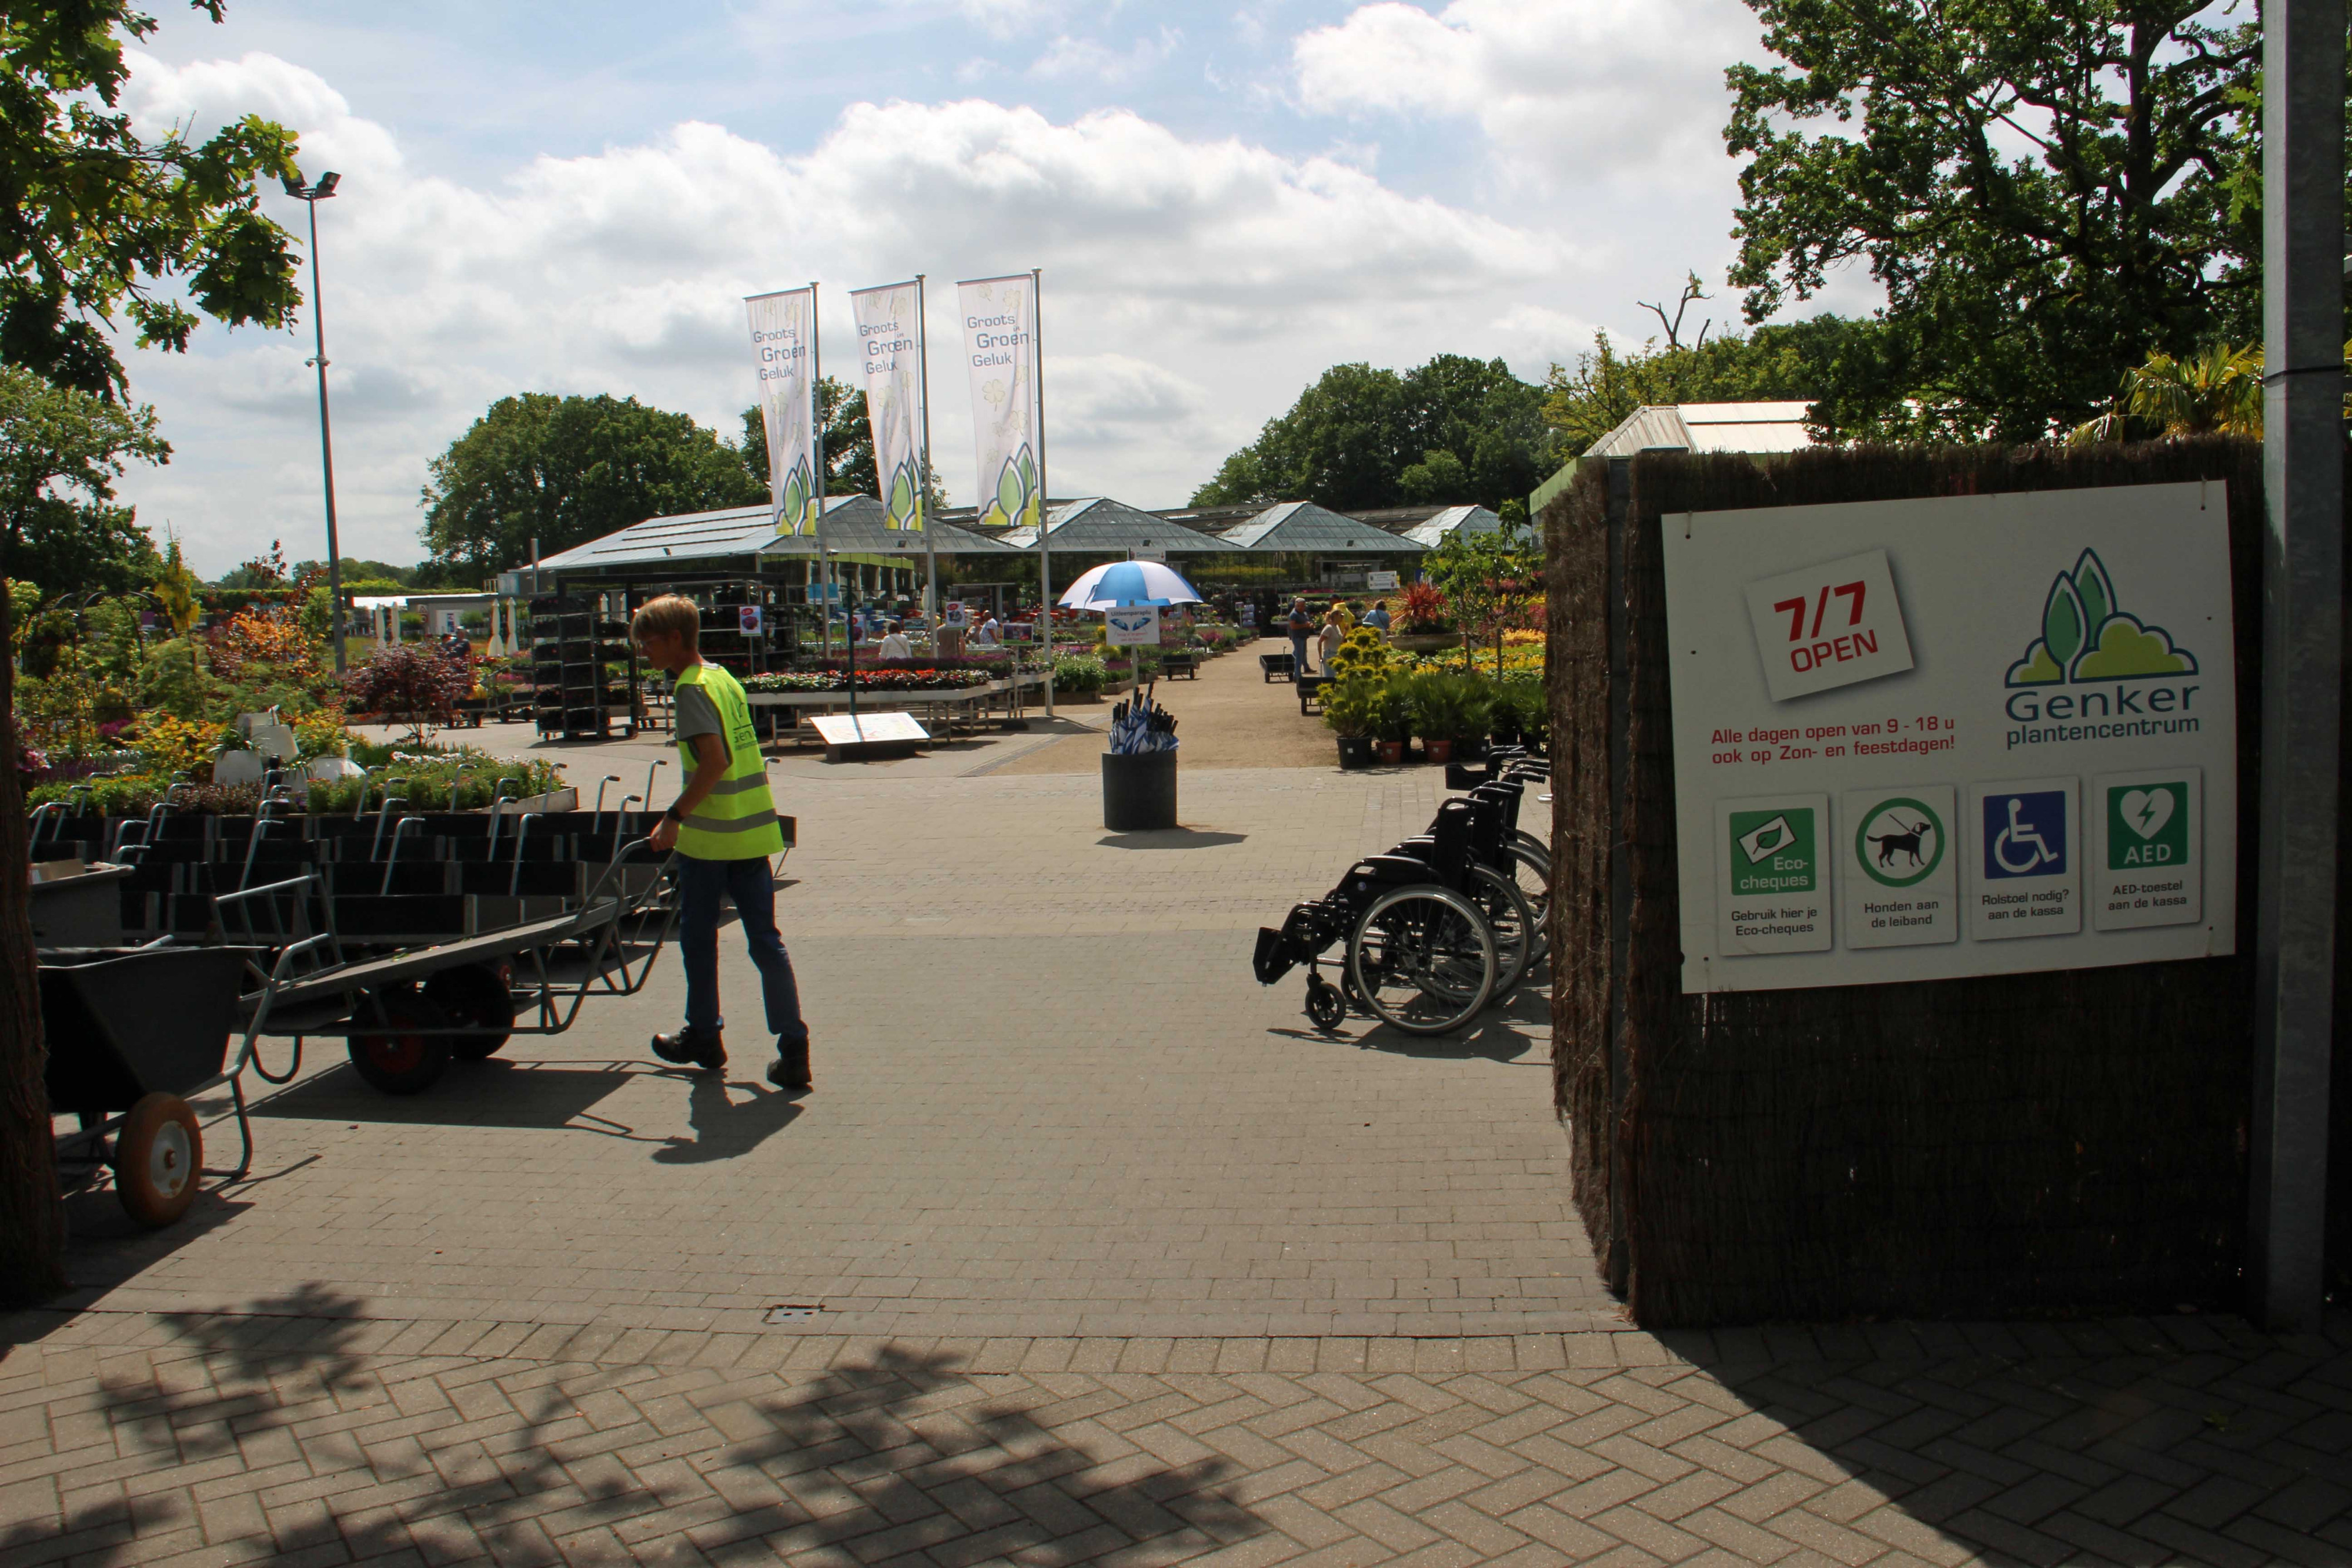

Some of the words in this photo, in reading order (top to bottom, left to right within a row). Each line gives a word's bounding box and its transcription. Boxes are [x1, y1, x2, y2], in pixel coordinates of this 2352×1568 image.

[860, 322, 899, 337] Groots
[967, 315, 1015, 329] Groots
[754, 329, 796, 343] Groots
[977, 333, 1029, 349] Groen
[761, 346, 806, 362] Groen
[868, 339, 913, 356] Groen
[972, 352, 1012, 367] Geluk
[760, 365, 794, 380] Geluk
[866, 360, 898, 375] Geluk
[1773, 580, 1866, 642] 7/7
[1790, 629, 1878, 673] OPEN
[2005, 686, 2200, 722] Genker
[1711, 728, 1742, 744] Alle
[1748, 727, 1799, 744] dagen
[1805, 726, 1846, 742] open
[1851, 723, 1880, 735] van
[1887, 718, 1899, 733] 9
[1916, 716, 1938, 731] 18
[1945, 718, 1954, 730] u
[2006, 718, 2200, 750] plantencentrum
[1712, 748, 1743, 764] ook
[1751, 750, 1772, 765] op
[1779, 745, 1818, 760] Zon-
[1825, 745, 1845, 757] en
[1854, 735, 1955, 755] feestdagen!
[2123, 844, 2171, 864] AED
[1773, 856, 1808, 871] Eco-
[1740, 875, 1809, 891] cheques
[2113, 880, 2183, 895] AED-toestel
[1982, 892, 2028, 905] Rolstoel
[2032, 888, 2069, 902] nodig?
[2108, 901, 2130, 910] aan
[2134, 898, 2148, 908] de
[2153, 897, 2187, 907] kassa
[1731, 909, 1776, 921] Gebruik
[1780, 908, 1803, 919] hier
[1807, 907, 1818, 919] je
[1865, 901, 1912, 914] Honden
[1916, 901, 1939, 910] aan
[1988, 911, 2009, 920] aan
[2013, 908, 2027, 918] de
[2030, 907, 2064, 917] kassa
[1871, 917, 1886, 928] de
[1889, 914, 1932, 927] leiband
[1736, 924, 1814, 936] Eco-cheques
